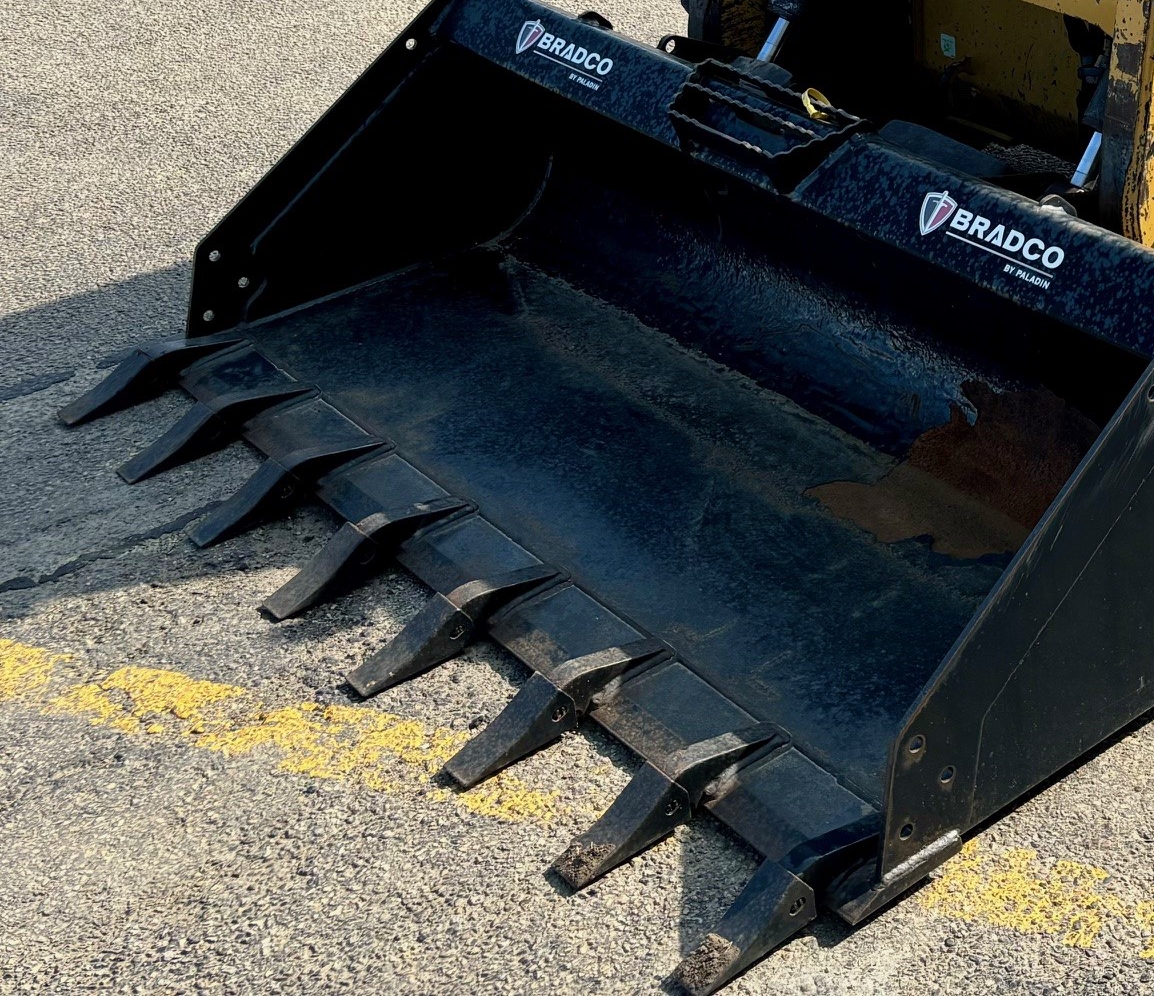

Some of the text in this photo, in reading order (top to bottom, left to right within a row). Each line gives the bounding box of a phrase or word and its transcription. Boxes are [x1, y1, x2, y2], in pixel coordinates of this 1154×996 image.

[537, 33, 613, 75] BRADCO
[577, 76, 600, 91] PALADIN
[950, 208, 1064, 269] BRADCO
[1003, 264, 1050, 290] BY PALADIN
